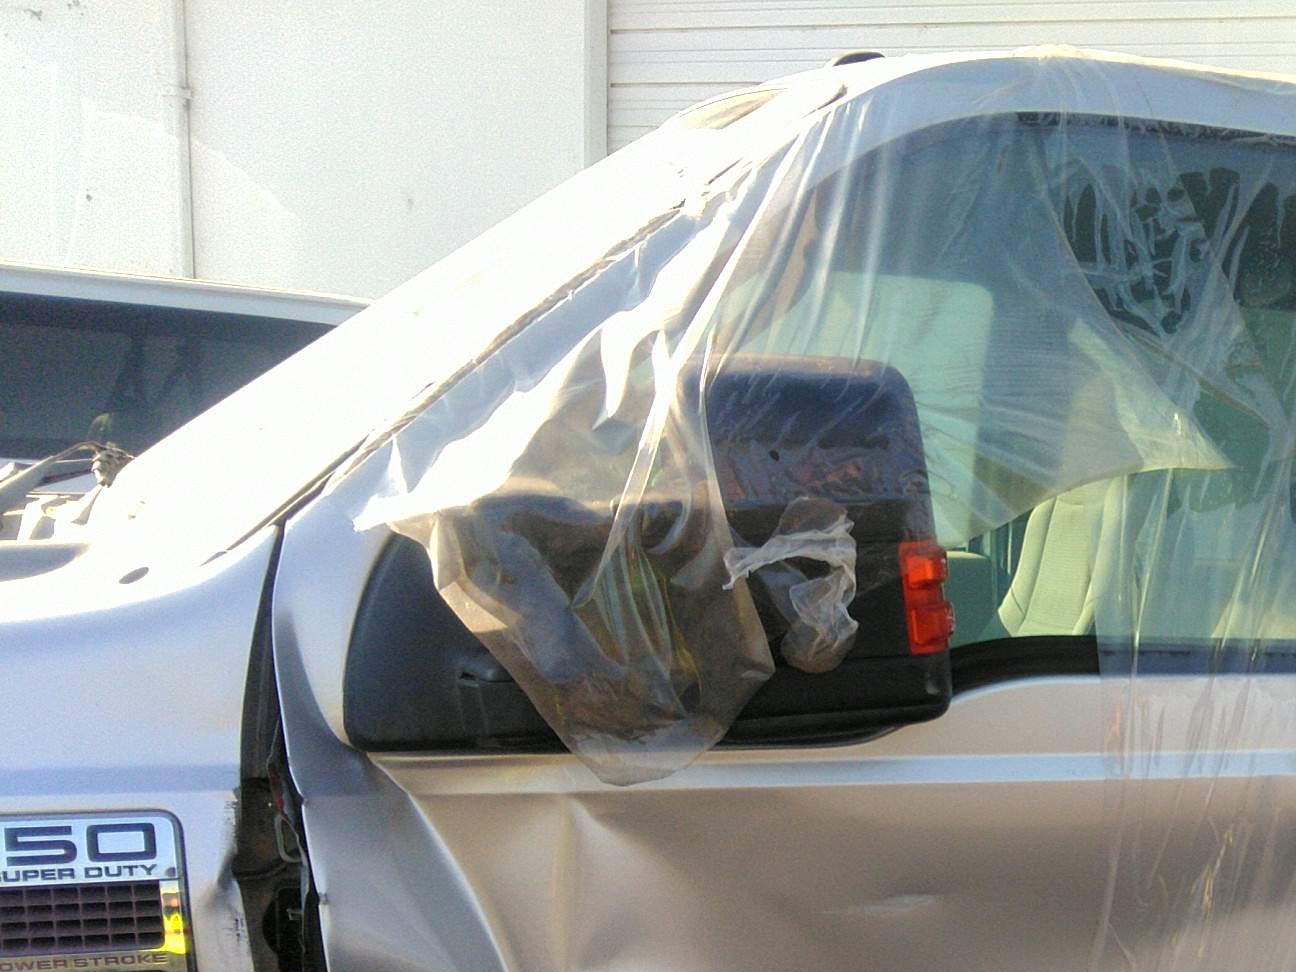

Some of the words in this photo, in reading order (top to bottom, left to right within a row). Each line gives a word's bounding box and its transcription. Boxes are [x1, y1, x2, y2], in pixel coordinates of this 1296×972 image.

[0, 868, 76, 882] UPER
[84, 864, 157, 880] DUTY
[0, 960, 68, 972] OWER
[73, 954, 168, 968] STROKE
